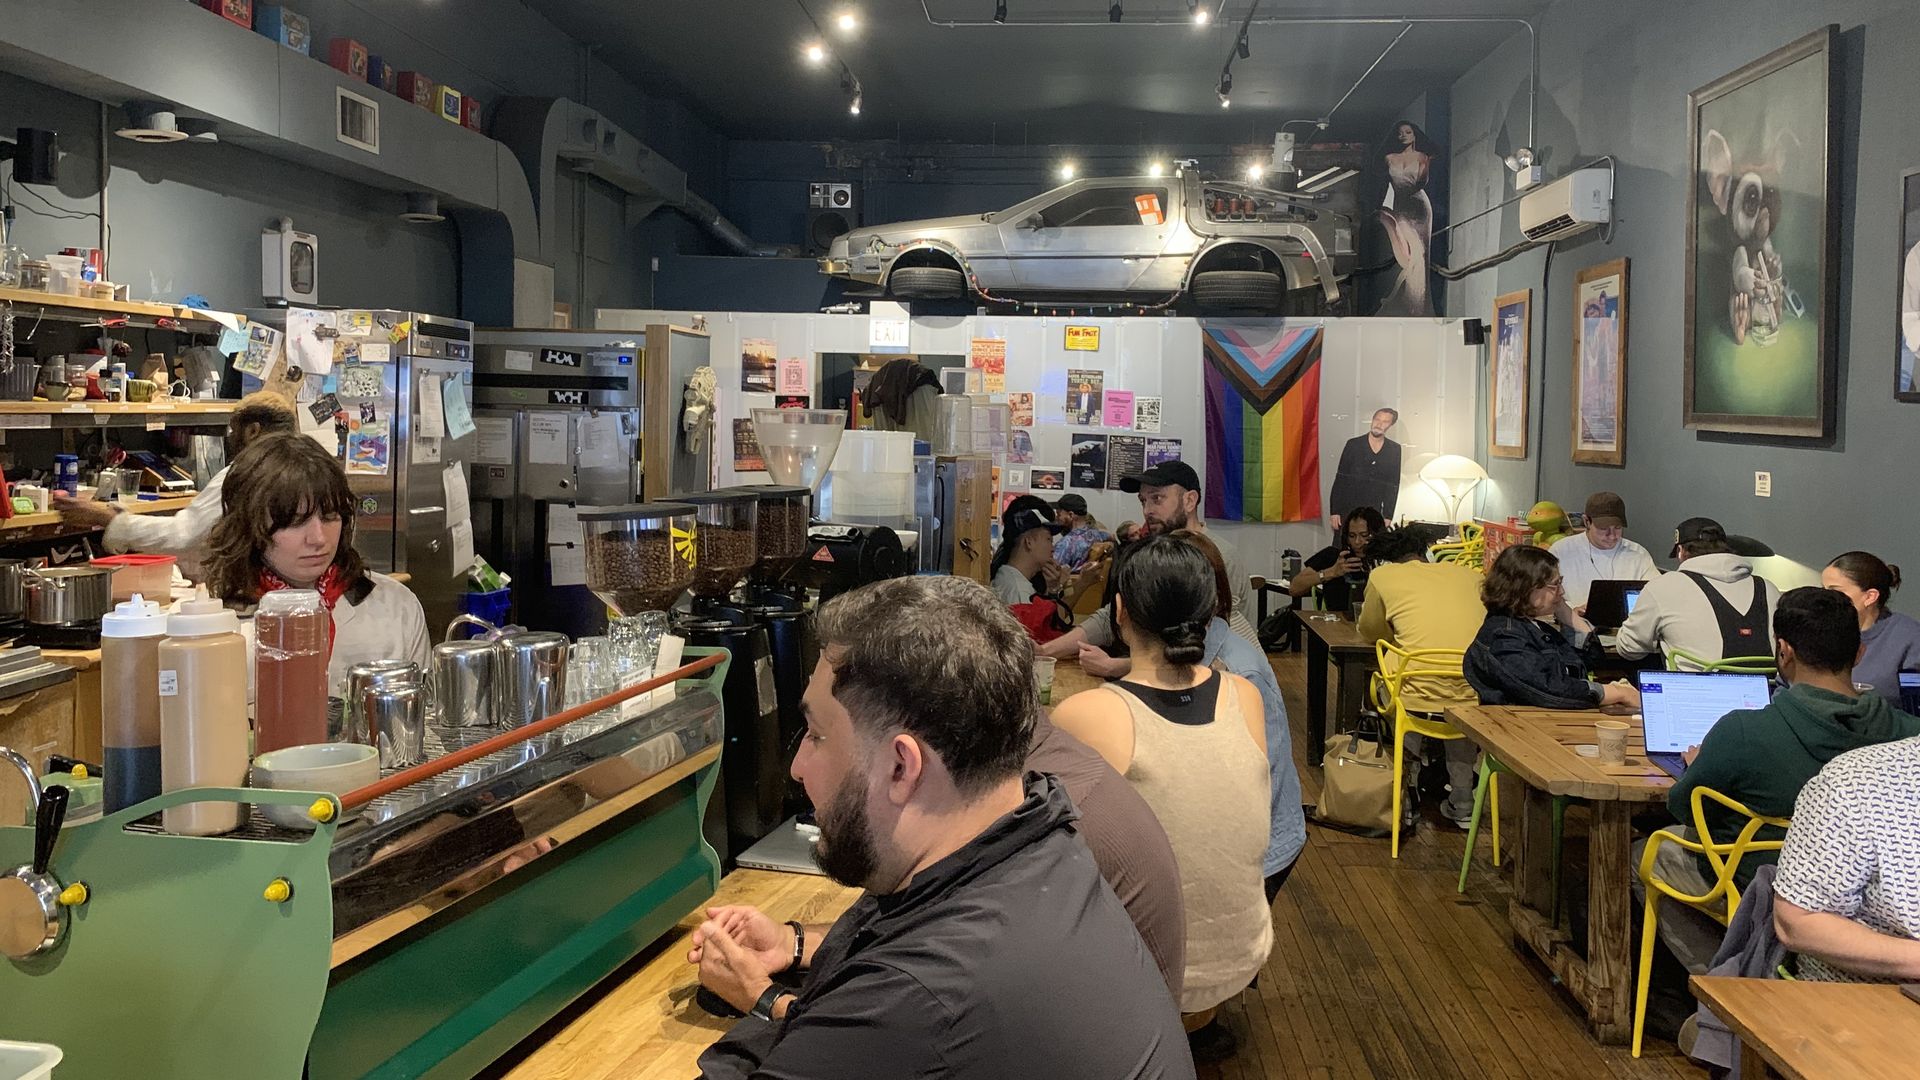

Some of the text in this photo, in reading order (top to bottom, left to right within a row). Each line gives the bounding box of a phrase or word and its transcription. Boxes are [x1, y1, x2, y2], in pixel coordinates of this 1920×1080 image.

[875, 321, 904, 341] EXIT
[1068, 328, 1097, 337] FUN FACT
